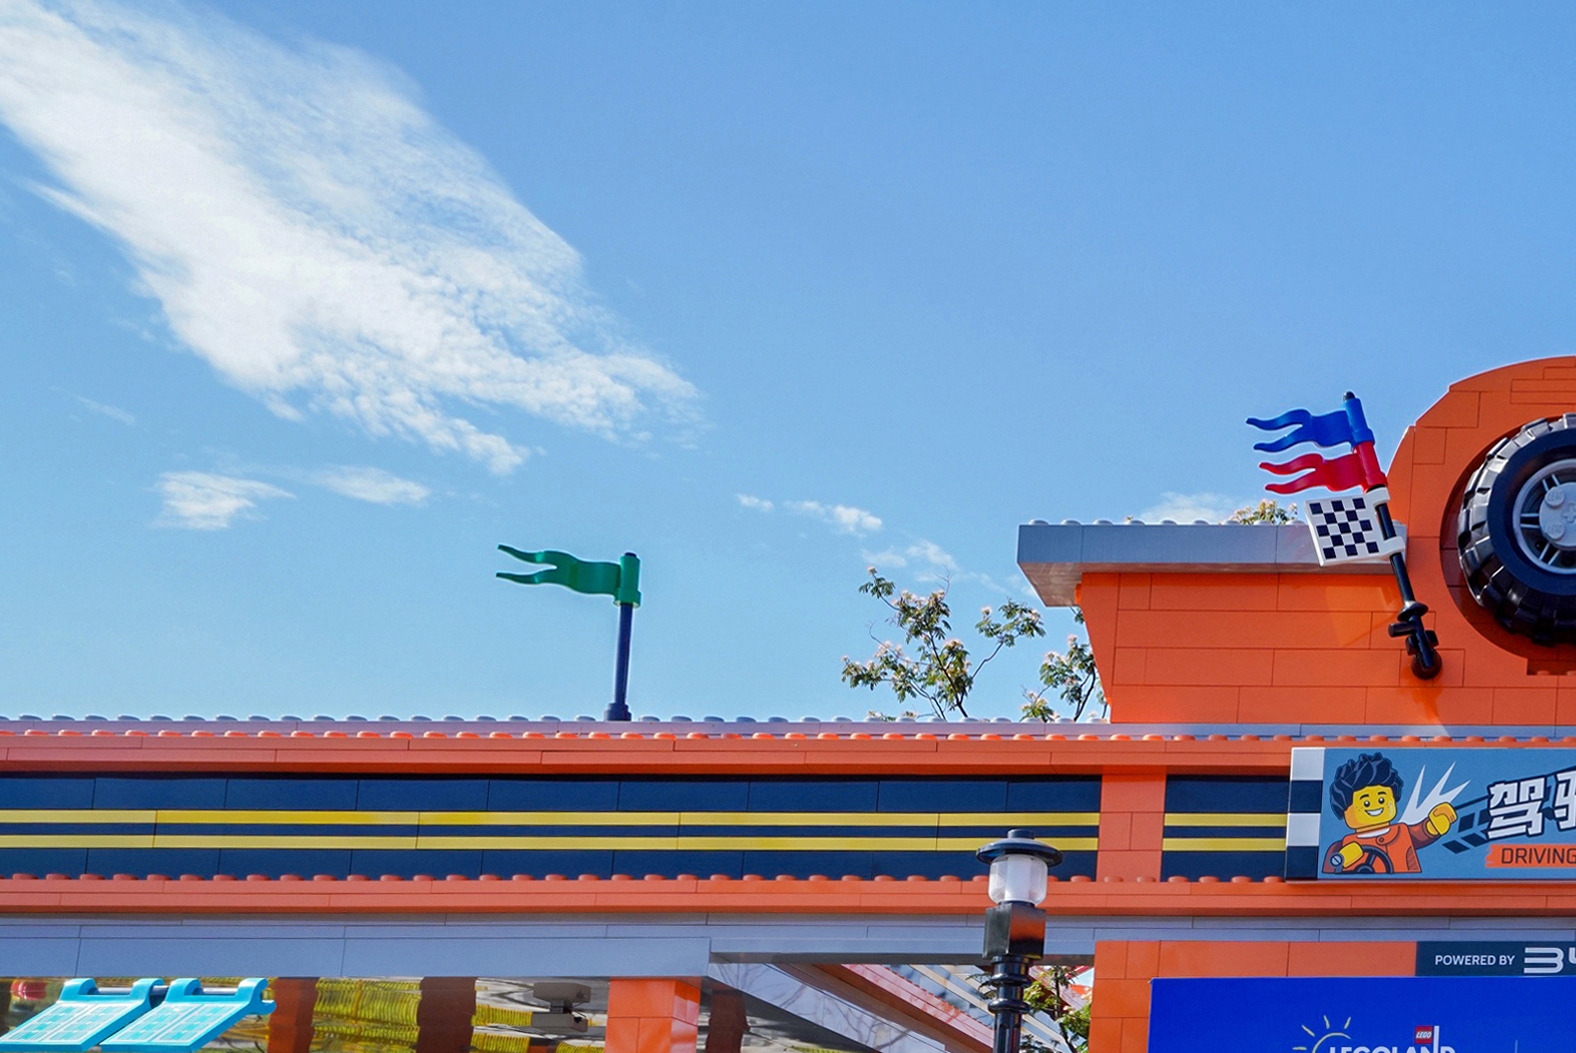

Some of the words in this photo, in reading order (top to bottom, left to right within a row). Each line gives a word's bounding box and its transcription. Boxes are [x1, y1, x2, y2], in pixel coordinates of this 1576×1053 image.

[1434, 954, 1495, 967] POWERED
[1498, 954, 1515, 967] BY
[1415, 1030, 1433, 1039] LEGO
